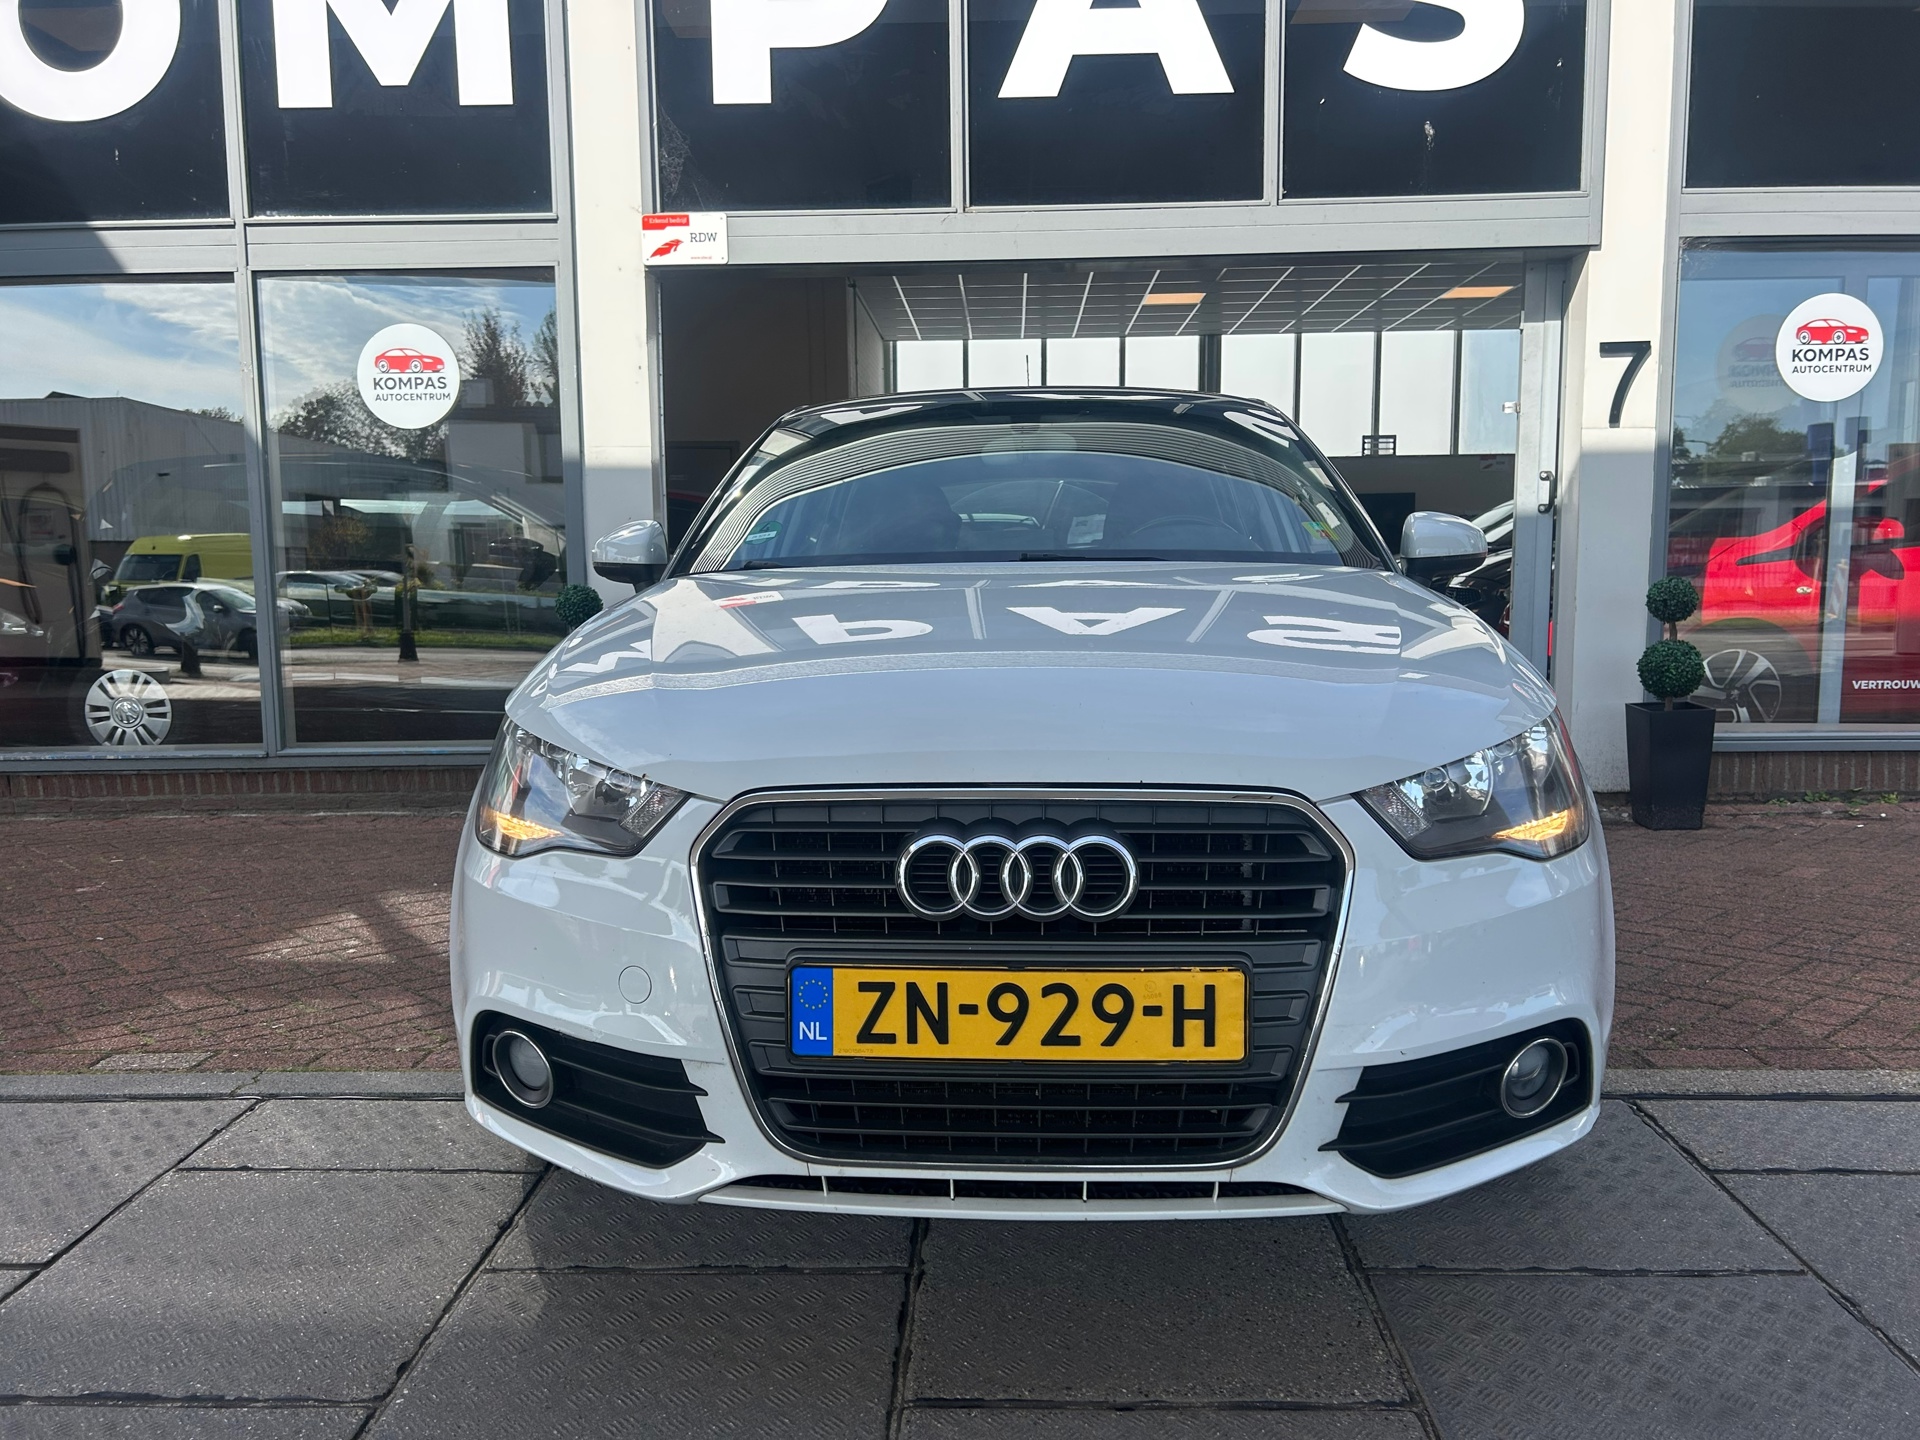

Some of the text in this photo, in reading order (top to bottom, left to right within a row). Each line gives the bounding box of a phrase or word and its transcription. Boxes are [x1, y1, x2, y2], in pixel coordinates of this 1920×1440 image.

[690, 232, 718, 243] RDW
[1791, 347, 1870, 362] KOMPAS
[1791, 364, 1872, 374] AUTOCENTRUM
[373, 376, 447, 390] KOMPAS
[1599, 340, 1652, 428] 7
[375, 392, 451, 401] AUTOCENTRUM
[856, 981, 1216, 1048] ZN-929-H
[799, 1021, 828, 1041] NL
